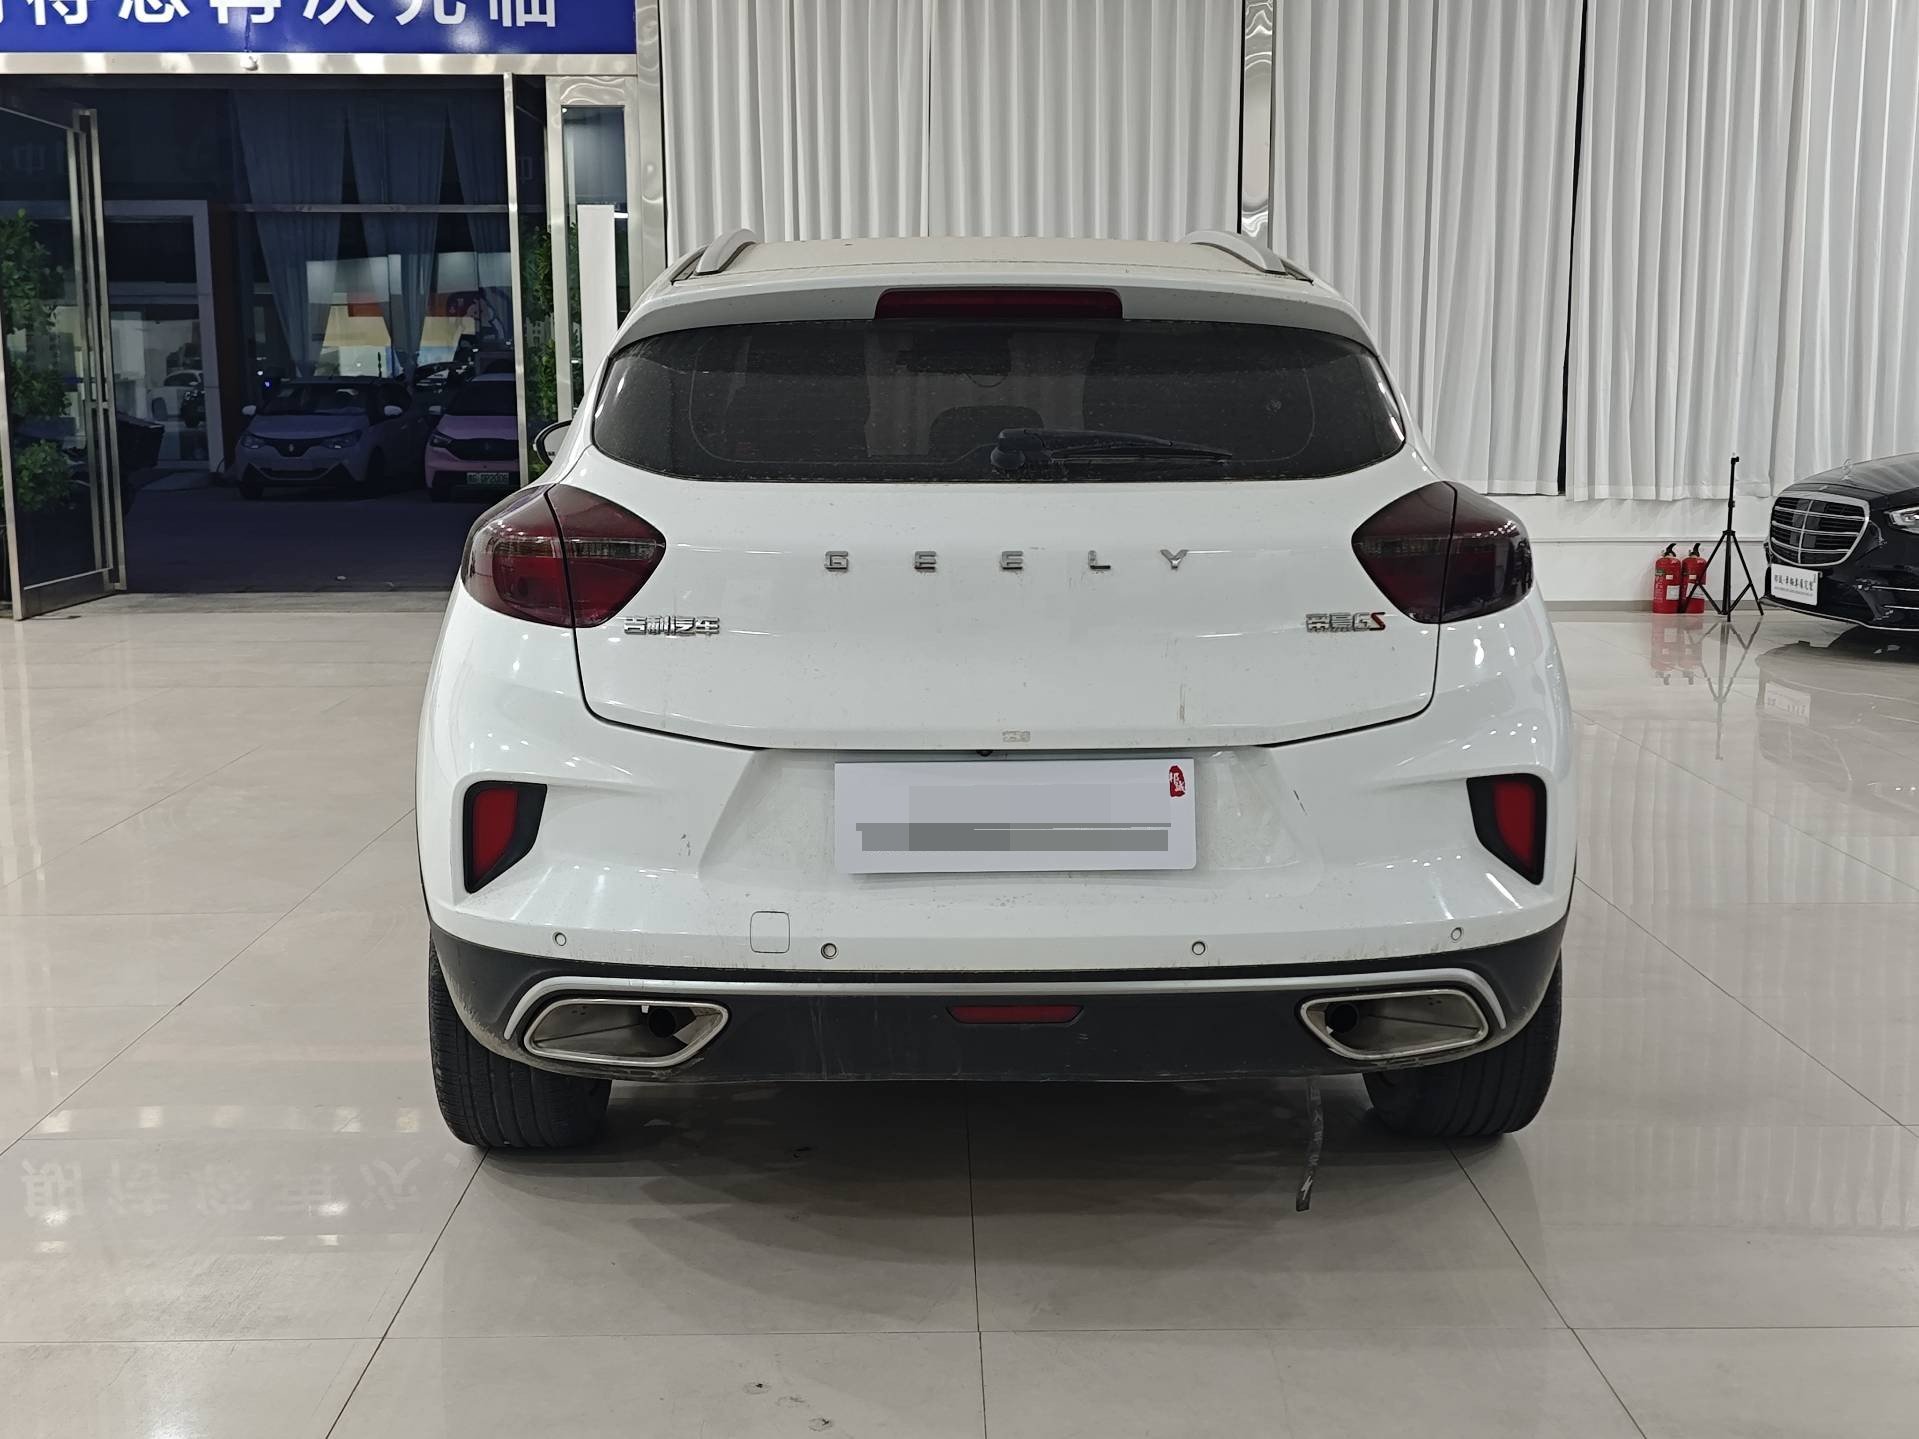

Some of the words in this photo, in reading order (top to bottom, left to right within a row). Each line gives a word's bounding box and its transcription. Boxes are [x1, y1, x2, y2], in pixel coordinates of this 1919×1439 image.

[824, 550, 1188, 571] GEELY
[624, 615, 720, 636] 吉利汽车
